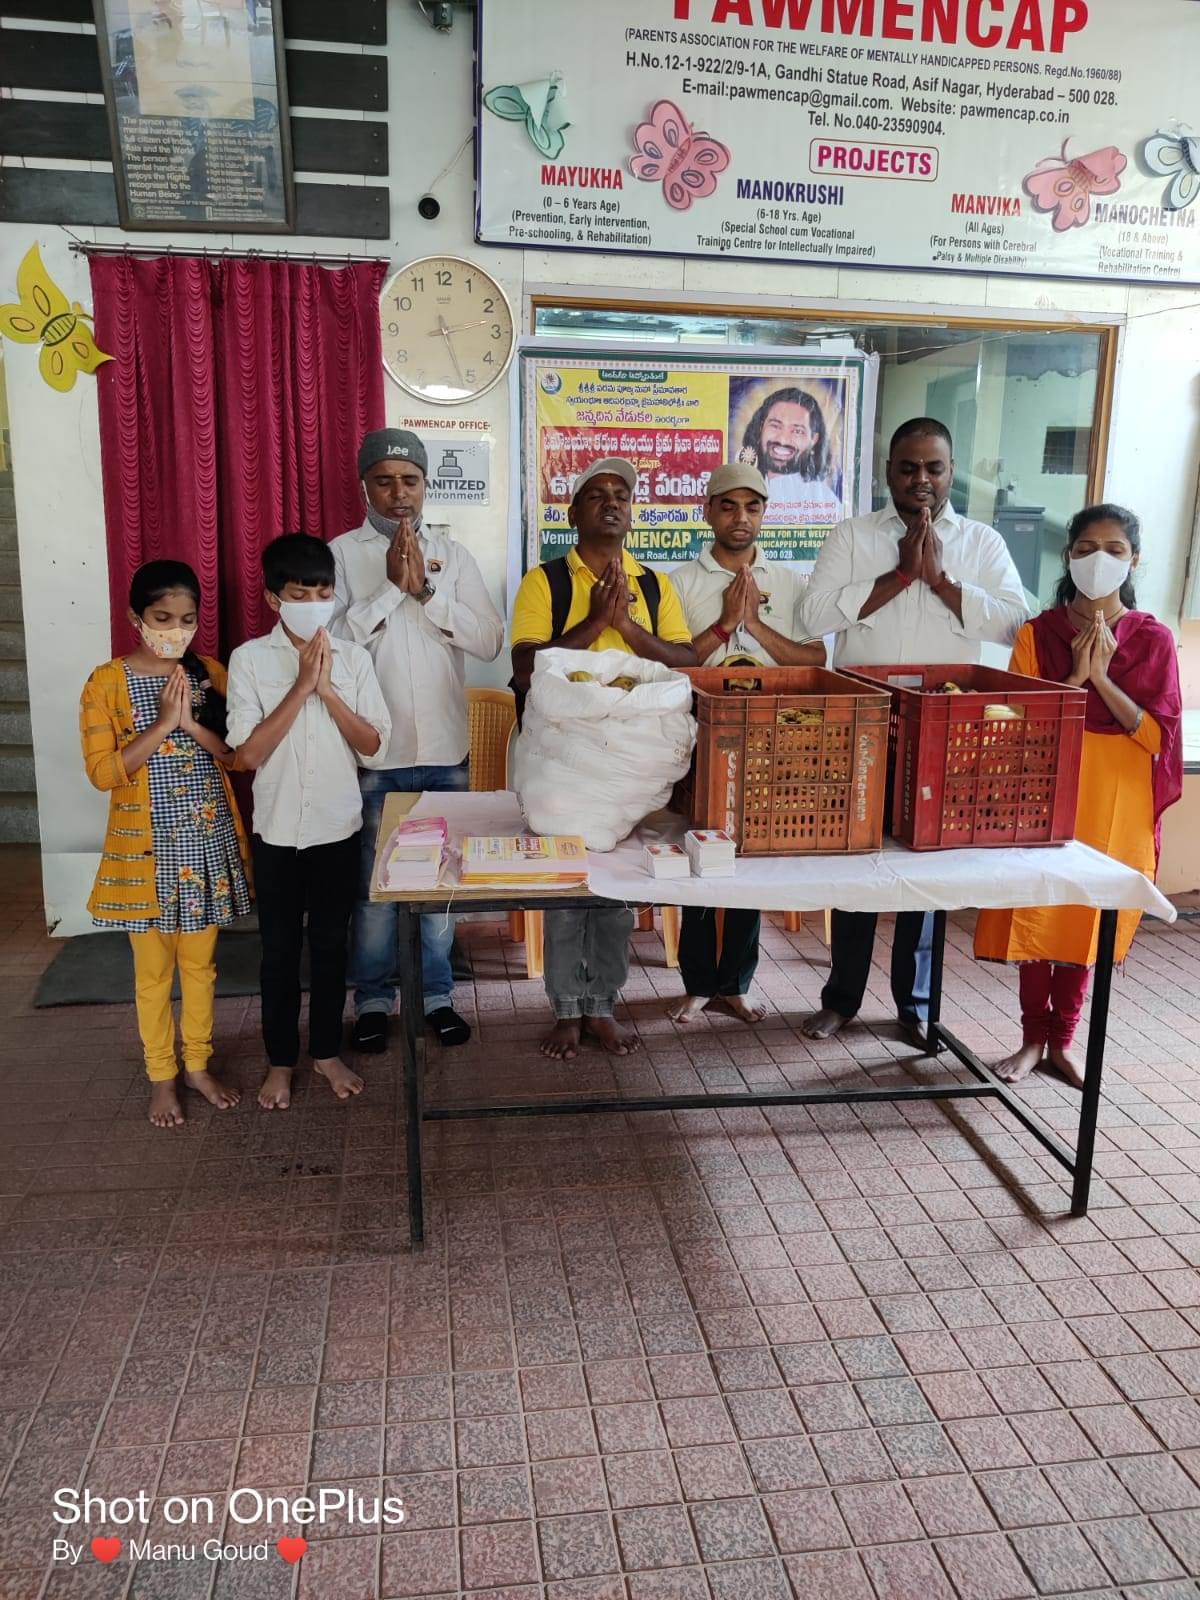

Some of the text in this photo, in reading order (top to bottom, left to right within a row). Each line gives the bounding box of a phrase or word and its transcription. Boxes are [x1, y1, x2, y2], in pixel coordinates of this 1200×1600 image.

[626, 28, 677, 43] (PARENTS
[680, 33, 750, 50] ASSOCIATION
[753, 39, 774, 51] FOR
[777, 42, 796, 54] THE
[800, 43, 848, 58] WELFARE
[850, 48, 864, 59] OF
[867, 49, 917, 64] MENTALLY
[921, 54, 990, 70] HANDICAPPED
[776, 64, 822, 82] Gandhi
[827, 68, 868, 86] Statue
[872, 73, 909, 91] Road,
[913, 77, 939, 92] Asif
[942, 79, 981, 98] Nagar,
[986, 83, 1054, 101] Hyderabad
[1069, 89, 1090, 103] 500
[1094, 91, 1118, 106] 028.
[902, 97, 956, 115] Website:
[960, 104, 1069, 124] pawmencap.co.in
[808, 111, 829, 126] Tel.
[818, 145, 932, 175] PROJECTS
[541, 165, 623, 190] MAYUKHA
[736, 178, 844, 205] MANOKRUSHI
[544, 196, 552, 209] (0
[564, 198, 569, 208] 6
[572, 198, 597, 210] Years
[600, 200, 620, 213] Age)
[952, 194, 1021, 216] MANVIKA
[512, 210, 566, 225] (Prevention,
[570, 214, 592, 229] Early
[783, 210, 799, 222] Yrs.
[802, 211, 821, 224] Age)
[722, 221, 854, 240] (Special School cum Vocational
[966, 222, 1004, 236] (All Ages)
[577, 231, 583, 241] &
[587, 230, 652, 246] Rehabilitation)
[697, 234, 876, 257] Training Centre for Intellectually Impaired)
[930, 234, 1037, 252] (For Persons with Cerebral
[936, 251, 954, 263] Palsy
[965, 252, 992, 264] Multiple
[1098, 262, 1151, 274] Rehabilitation
[411, 278, 424, 292] 11
[435, 271, 452, 286] 12
[465, 279, 472, 293] 1
[394, 297, 412, 311] 10
[484, 299, 494, 313] 2
[388, 323, 399, 337] 9
[491, 324, 501, 339] 3
[397, 350, 408, 363] 8
[483, 351, 494, 365] 4
[466, 370, 475, 383] 5
[576, 410, 613, 425] జన్మదిన
[616, 408, 652, 422] వేడుకల
[387, 444, 409, 456] Lee
[625, 531, 692, 549] MENCAP
[778, 530, 791, 538] FOR
[794, 530, 806, 538] THE
[647, 551, 669, 561] Road,
[672, 551, 687, 560] Asif
